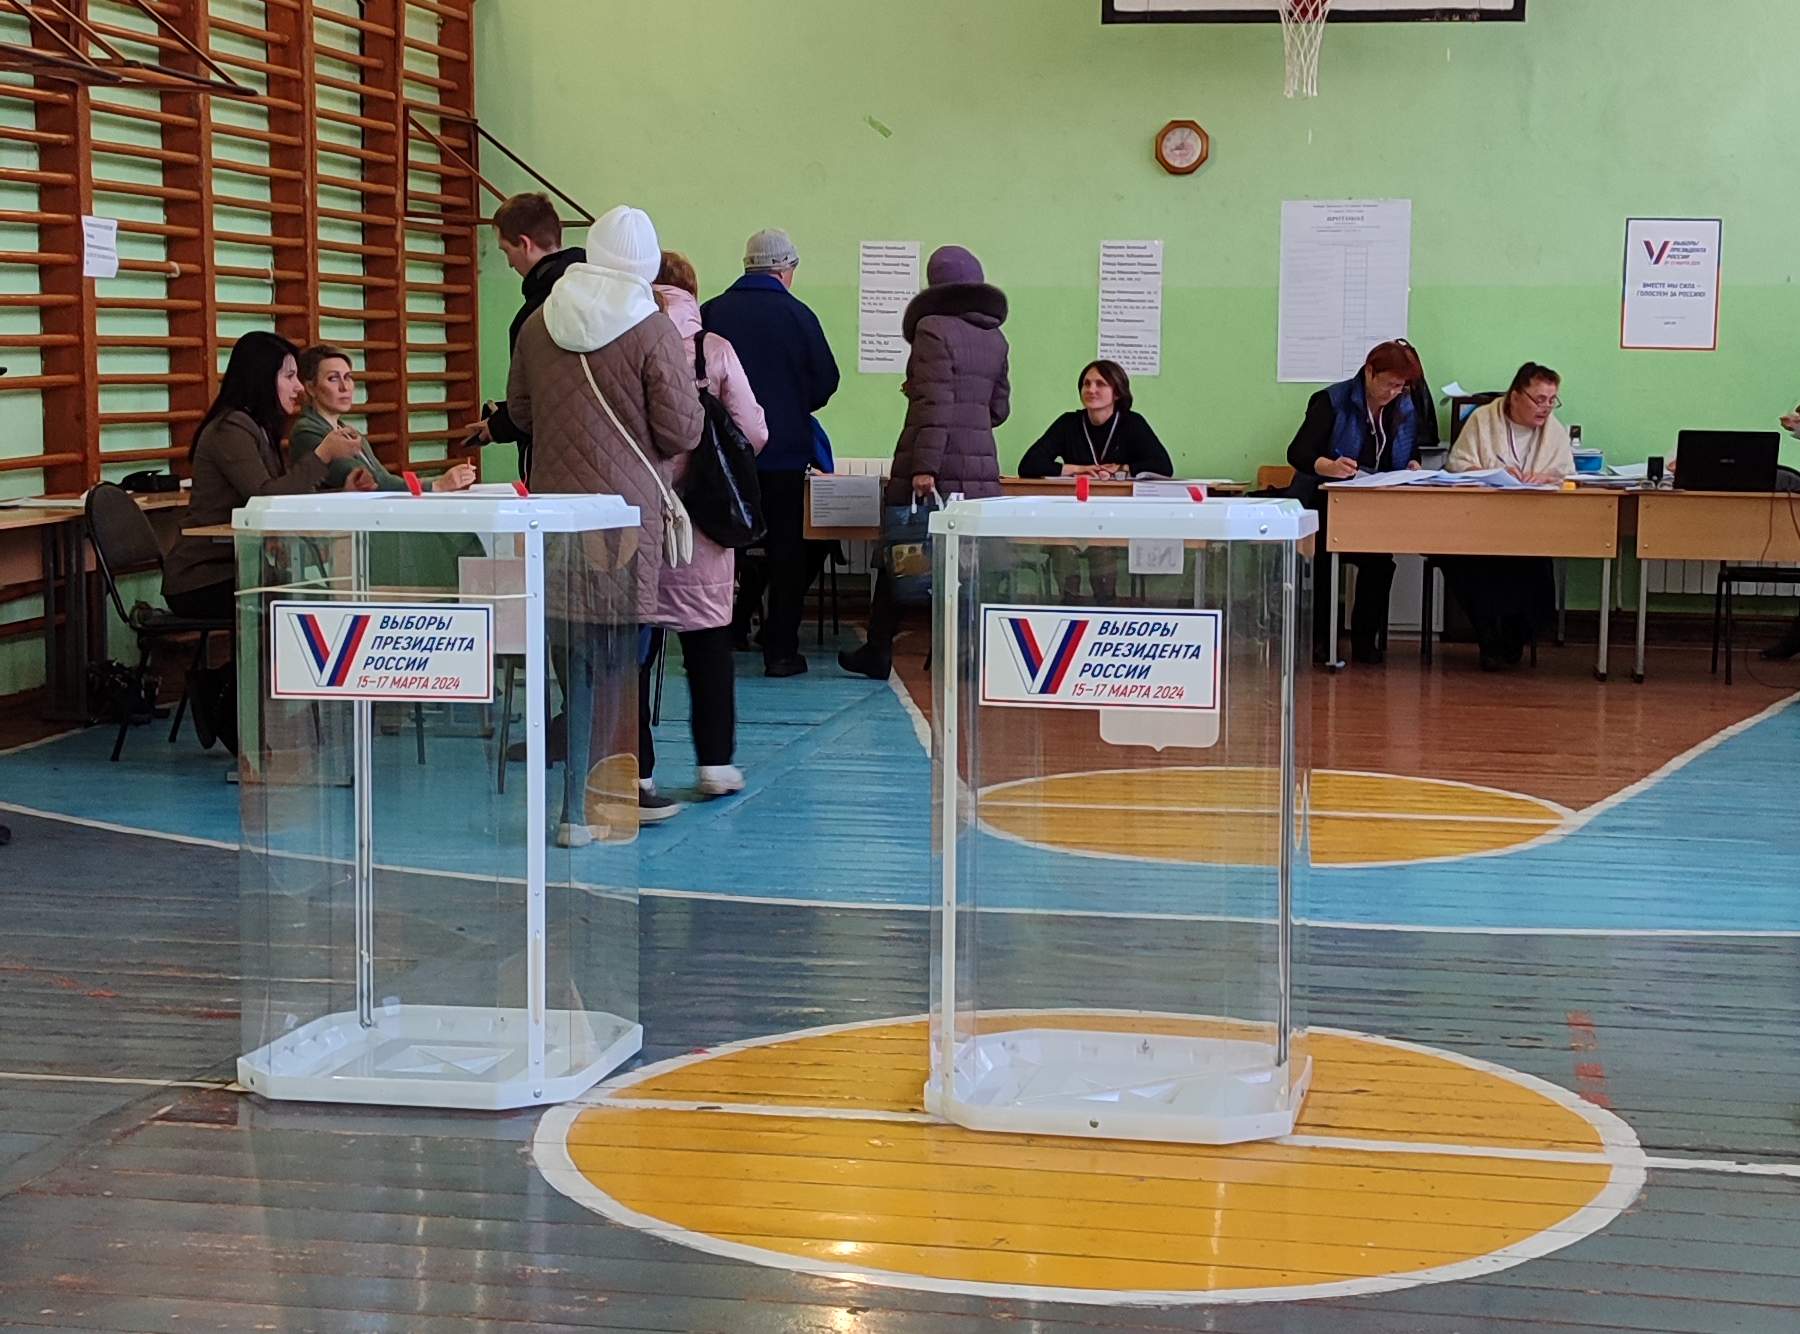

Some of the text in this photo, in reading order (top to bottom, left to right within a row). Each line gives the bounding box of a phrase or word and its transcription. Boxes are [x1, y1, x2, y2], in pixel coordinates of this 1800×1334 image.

[379, 614, 453, 631] ВЫБОРЫ
[1097, 620, 1179, 638] ВЫБОРЫ
[370, 635, 475, 653] ПРЕЗИДЕНТА
[1087, 641, 1202, 661] ПРЕЗИДЕНТА
[362, 656, 430, 672] РОССИИ
[1078, 663, 1152, 680] РОССИИ
[389, 676, 430, 690] МАРТА
[431, 676, 461, 690] 2024
[1108, 683, 1151, 698] МАРТА
[1152, 685, 1186, 700] 2024
